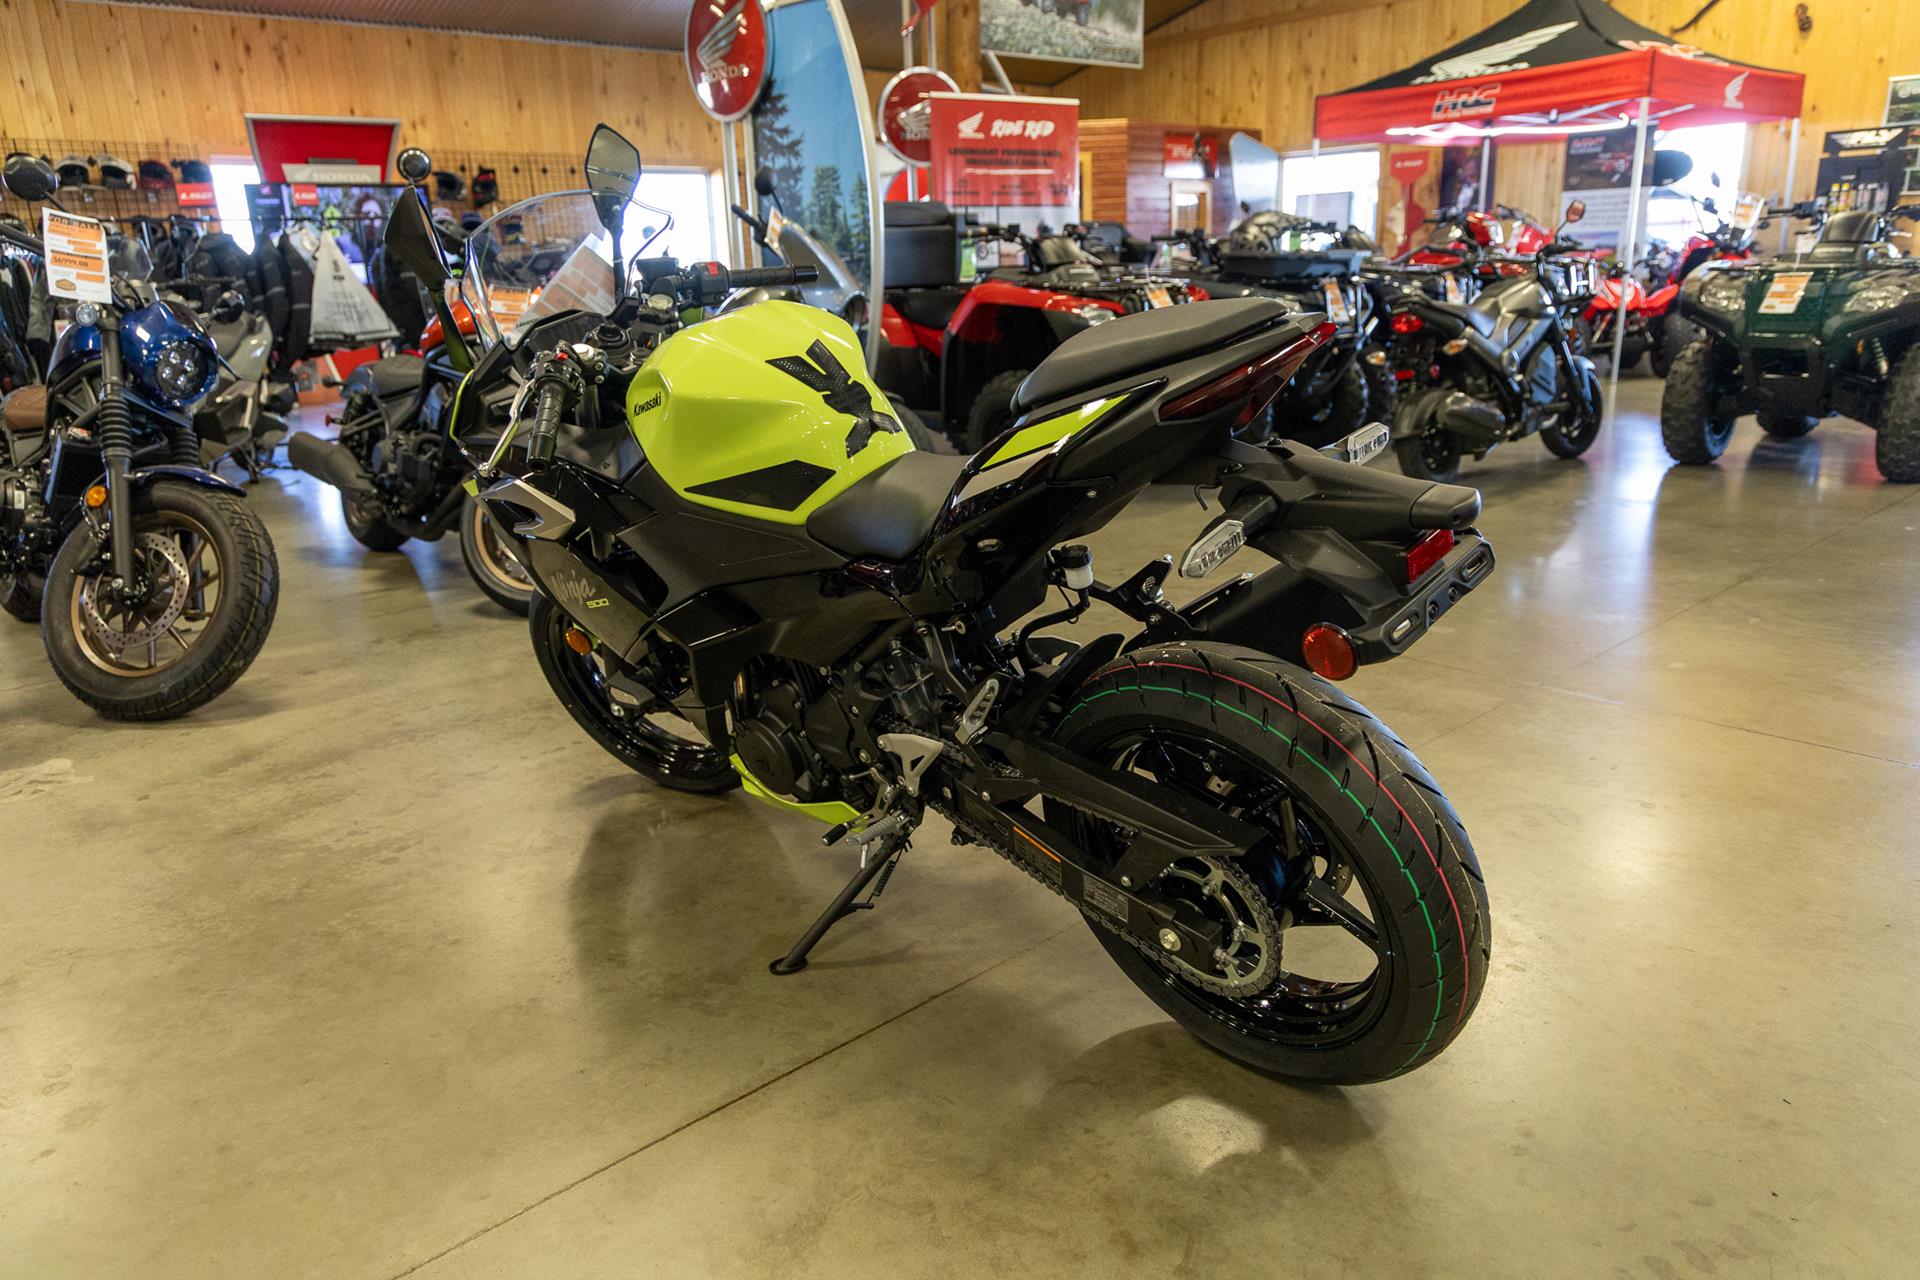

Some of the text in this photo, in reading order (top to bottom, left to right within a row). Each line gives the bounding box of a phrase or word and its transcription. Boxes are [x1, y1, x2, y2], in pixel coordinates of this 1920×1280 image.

[700, 63, 750, 83] HONDA
[1433, 81, 1502, 114] HRC
[990, 118, 1056, 140] RIDE RED
[312, 170, 372, 183] HONDA
[633, 391, 662, 418] Kawasaki
[551, 568, 597, 608] Ninja
[586, 598, 609, 609] 500
